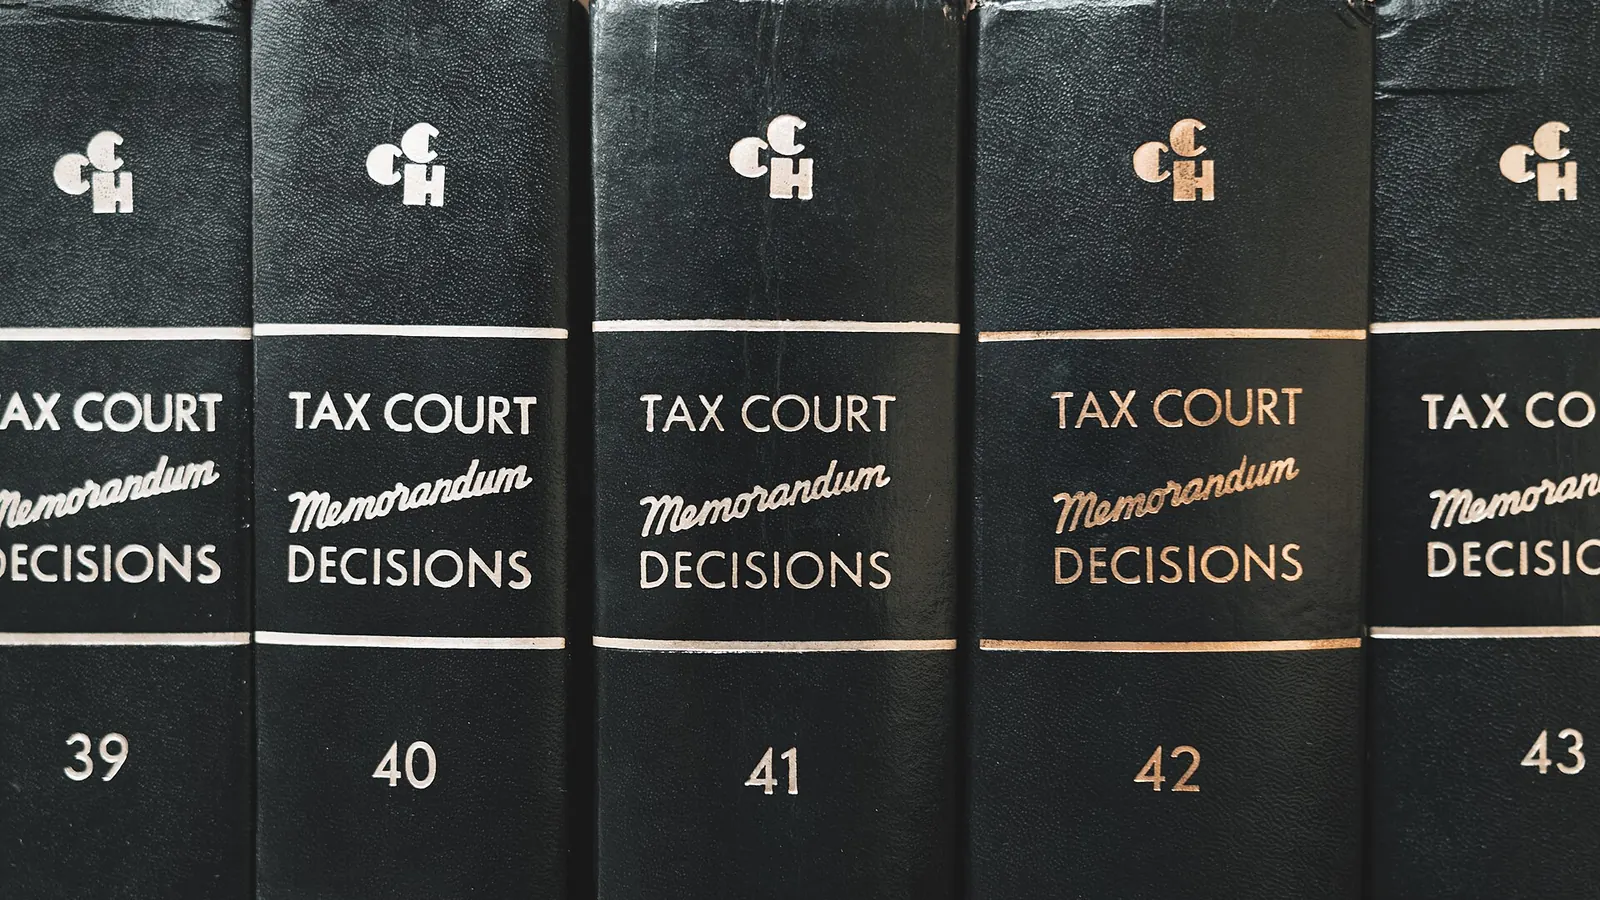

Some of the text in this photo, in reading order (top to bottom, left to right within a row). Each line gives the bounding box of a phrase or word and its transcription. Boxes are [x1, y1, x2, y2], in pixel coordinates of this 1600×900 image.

[0, 390, 222, 433] AX COURT
[289, 391, 537, 435] TAX COURT
[640, 393, 897, 433] TAX COURT
[1051, 387, 1303, 430] TAX COURT
[1421, 391, 1597, 429] TAX CO
[288, 459, 533, 534] Memorandum
[640, 459, 891, 538] Memorandum
[1053, 454, 1300, 535] Memorandum
[0, 543, 221, 584] ECISIONS
[288, 545, 532, 591] DECISIONS
[639, 550, 892, 591] DECISIONS
[1053, 543, 1304, 586] DECISIONS
[64, 732, 129, 783] 39
[372, 741, 437, 790] 40
[745, 746, 798, 796] 41
[1134, 745, 1201, 793] 42
[1521, 728, 1586, 775] 43
